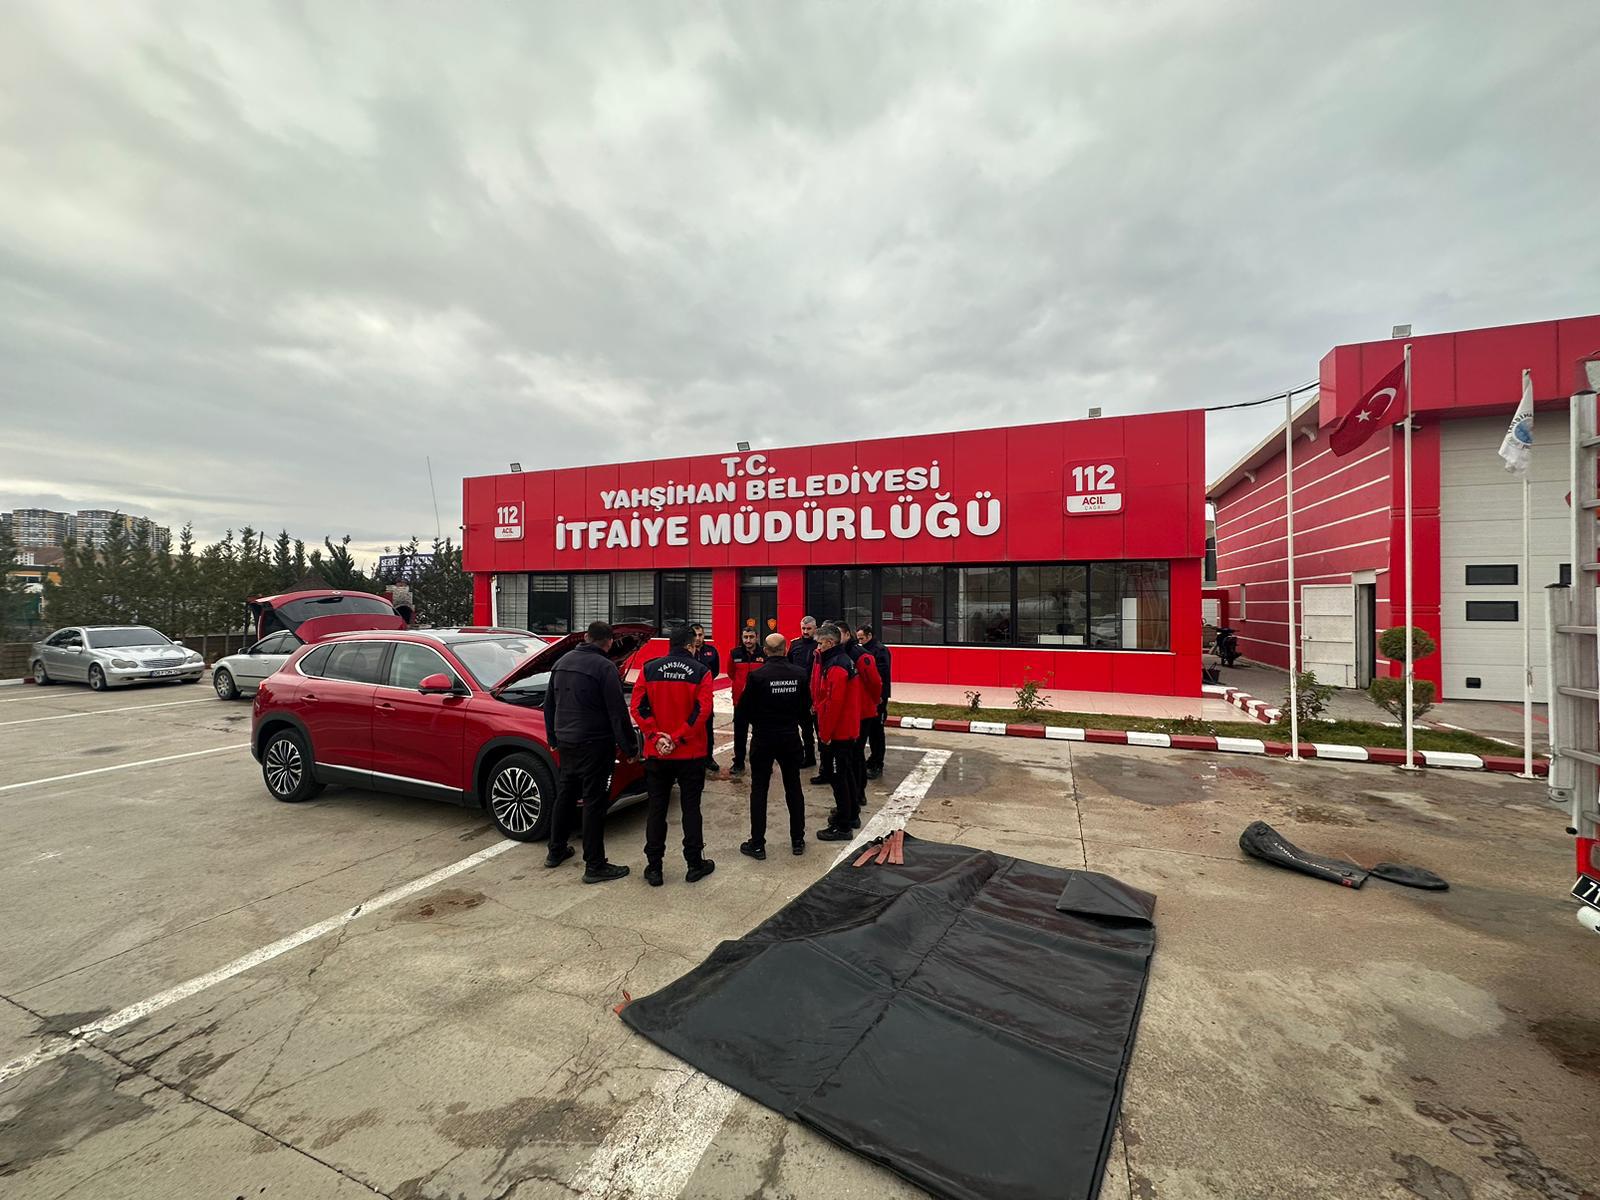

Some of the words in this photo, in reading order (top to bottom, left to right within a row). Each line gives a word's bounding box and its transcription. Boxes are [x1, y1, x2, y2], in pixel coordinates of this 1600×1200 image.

[720, 454, 776, 478] T.C.
[1072, 464, 1116, 492] 112
[600, 480, 736, 512] YAHŞİHAN
[745, 459, 940, 501] BELEDİYESİ
[497, 505, 519, 525] 112
[555, 511, 689, 551] İTFAİYE
[699, 490, 1001, 545] MÜDÜRLÜĞÜ
